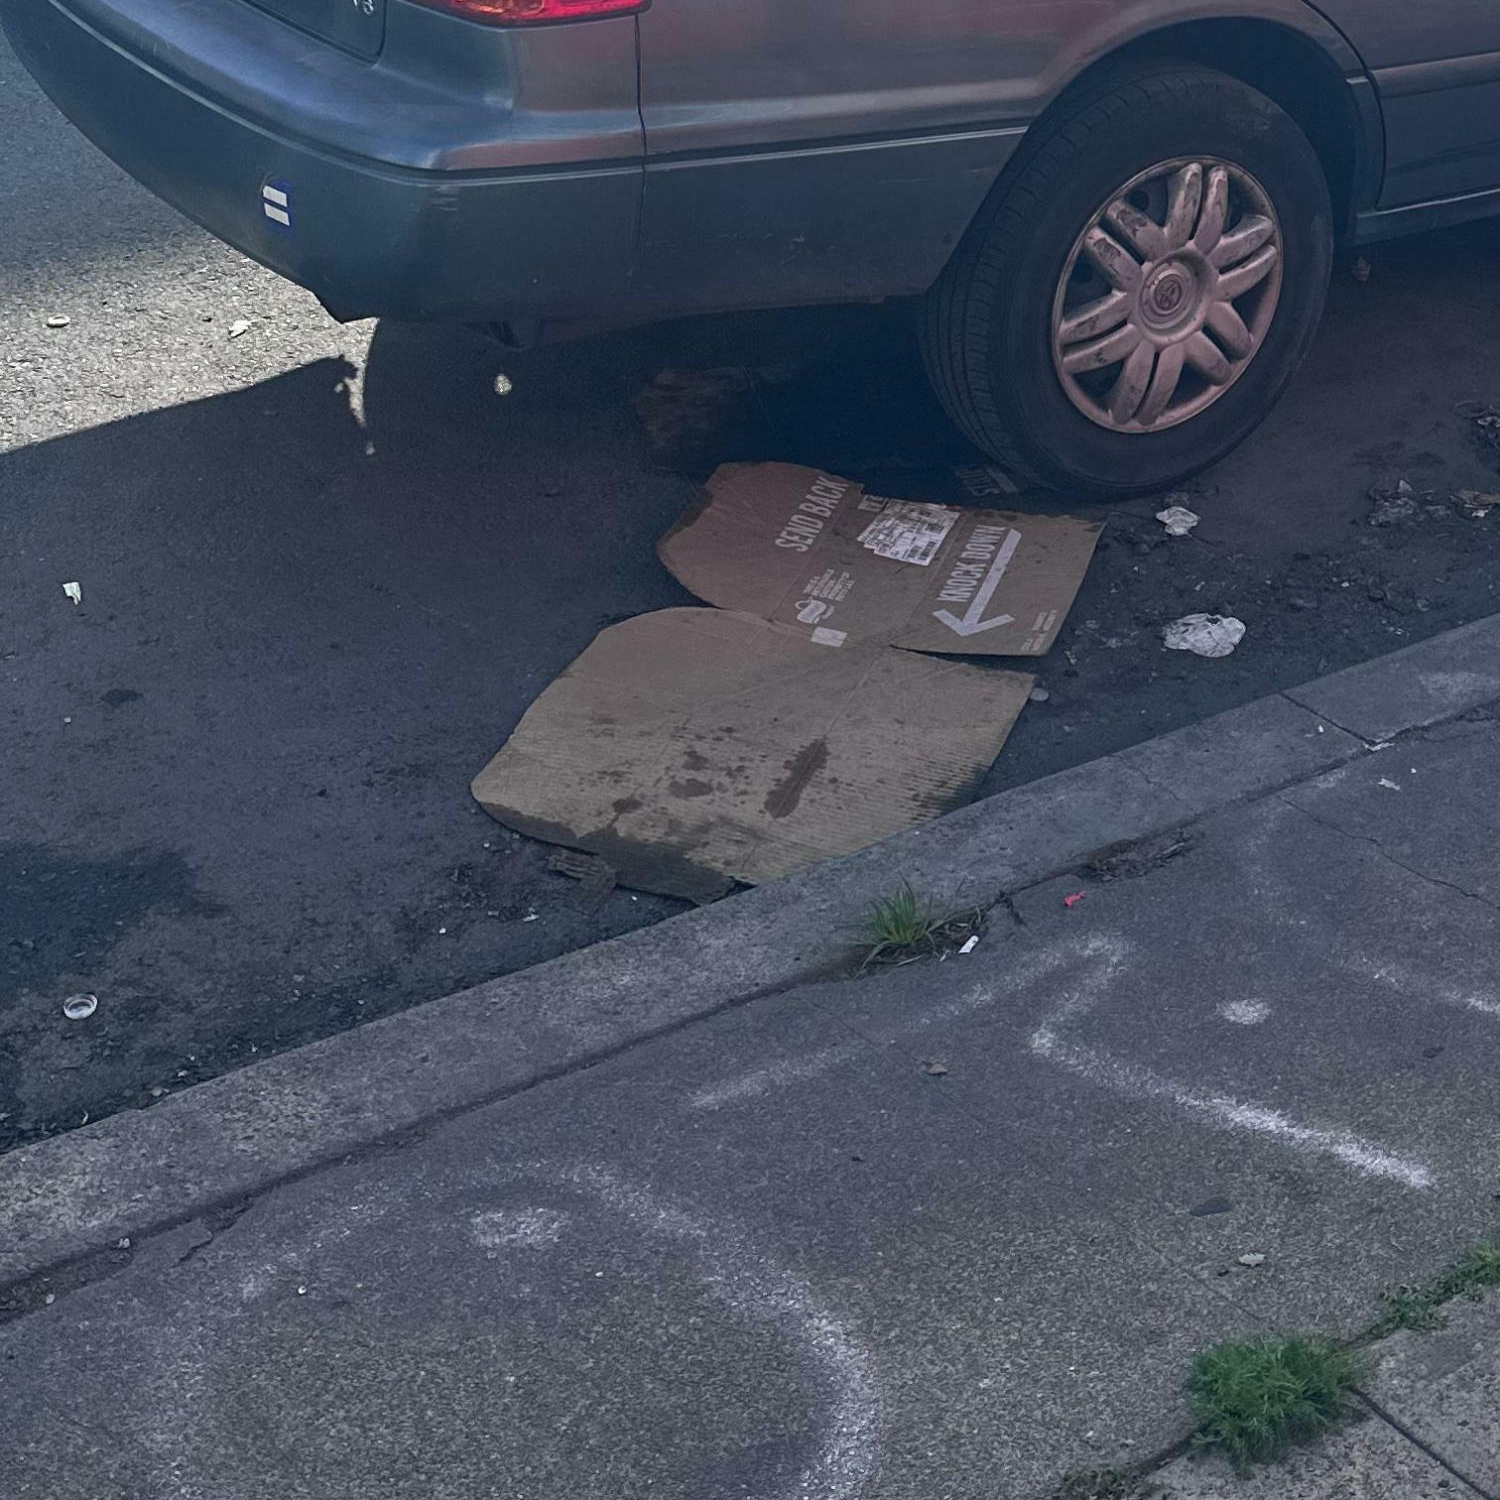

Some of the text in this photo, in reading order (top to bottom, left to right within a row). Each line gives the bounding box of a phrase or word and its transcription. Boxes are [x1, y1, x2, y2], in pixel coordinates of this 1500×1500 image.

[774, 514, 824, 552] SEND
[799, 476, 850, 517] BACK
[961, 524, 1007, 560] DOWN
[936, 562, 987, 603] KNOCK
